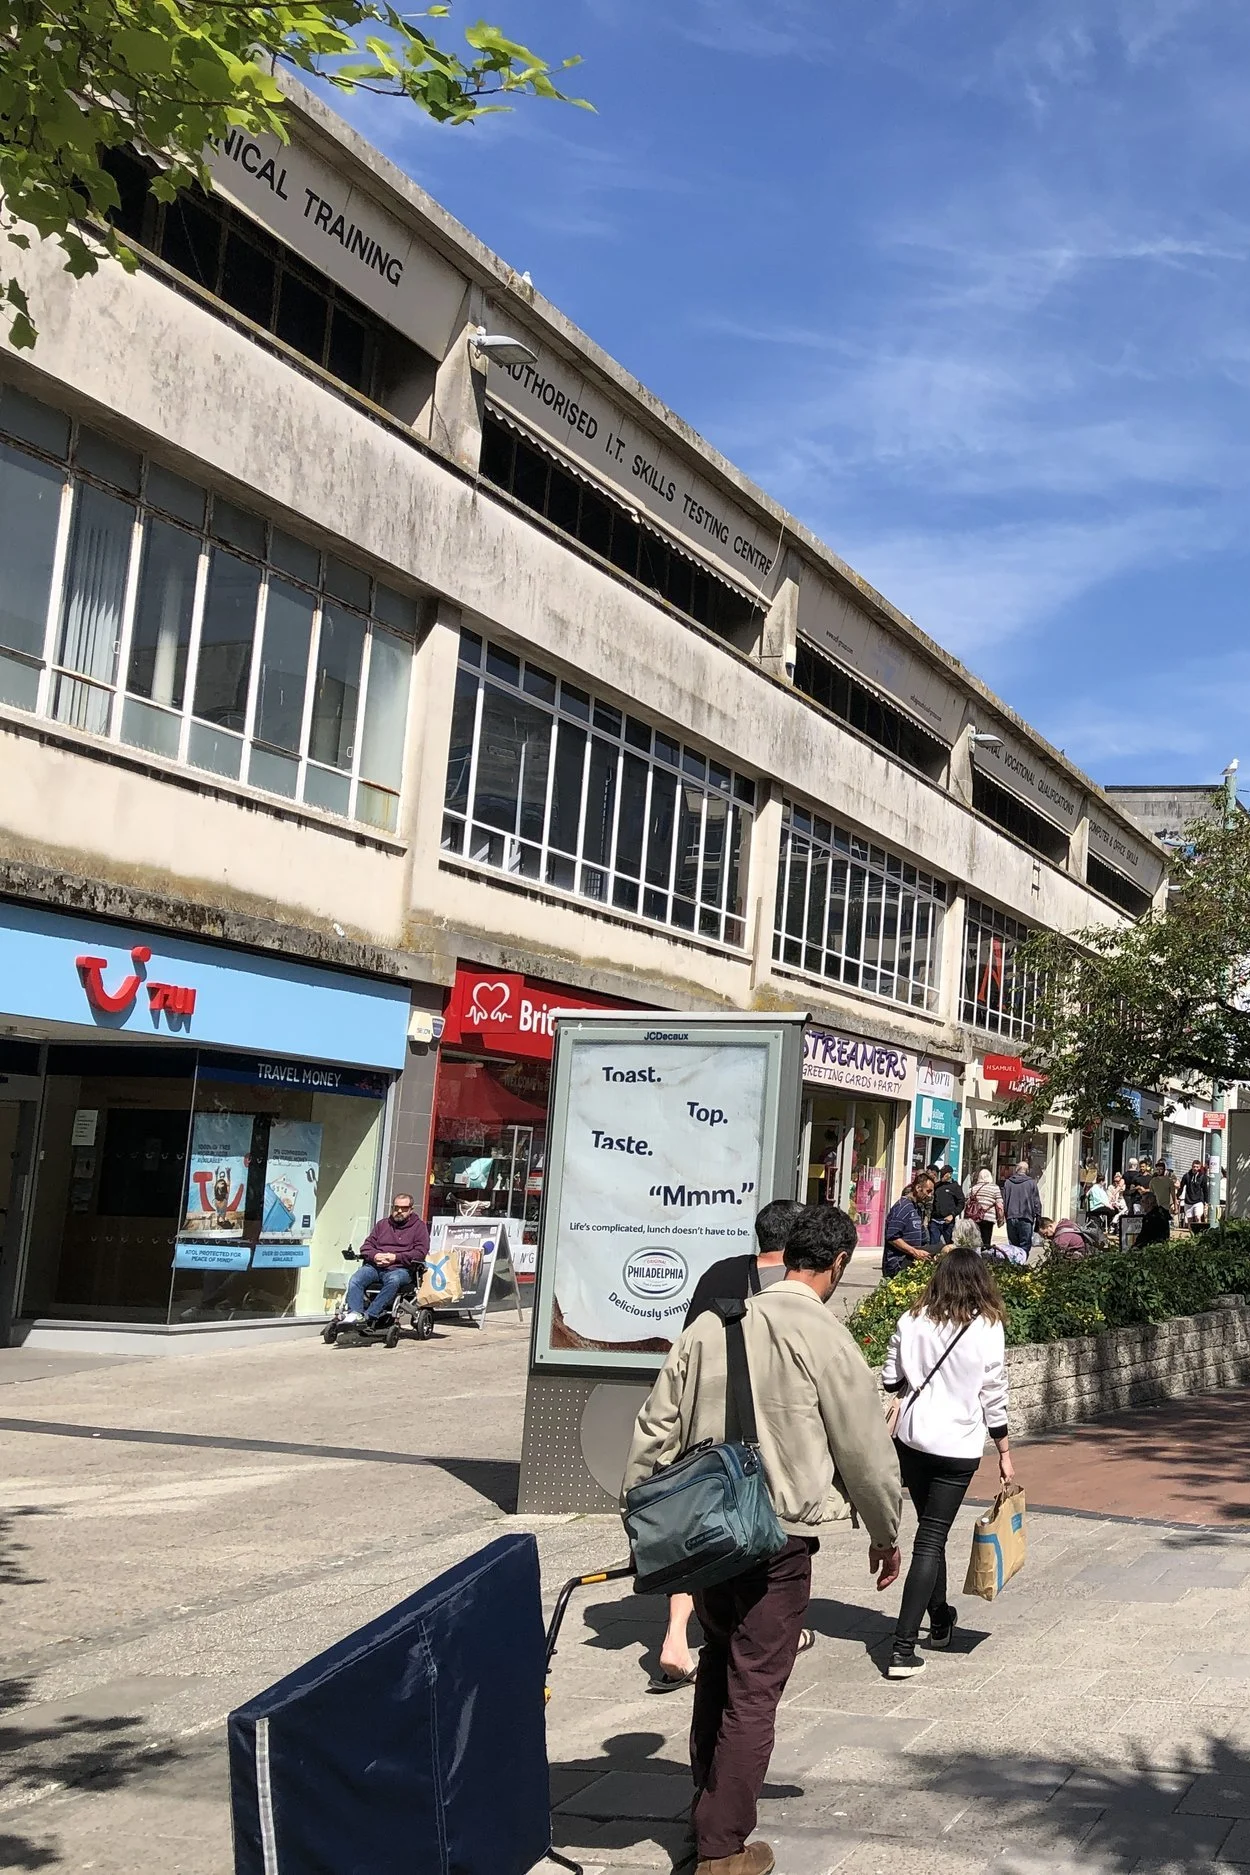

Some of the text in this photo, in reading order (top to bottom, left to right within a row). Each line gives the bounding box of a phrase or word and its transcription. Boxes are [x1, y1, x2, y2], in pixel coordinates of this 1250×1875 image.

[209, 129, 404, 287] NICAL TRAINING
[605, 432, 626, 463] I.T.
[632, 454, 676, 502] SKILLS
[682, 494, 729, 544] TESTING
[733, 536, 773, 576] CENTRE
[1004, 752, 1075, 816] VOCATIONAL QUALIFICATIONS
[1089, 819, 1111, 844] COMPUTER
[643, 1031, 689, 1041] JCDecaux
[258, 1063, 341, 1087] TRAVEL MONEY
[602, 1066, 662, 1083] Toast.
[803, 1063, 844, 1084] GREETING
[845, 1072, 872, 1089] CARDS
[877, 1079, 902, 1094] PARTY
[687, 1101, 728, 1126] Top.
[591, 1130, 653, 1156] Taste.
[649, 1182, 754, 1207] “Mmm.”
[570, 1222, 750, 1236] Life’s complicated, lunch doesn’t have to be.
[627, 1265, 684, 1280] PHILADELPHIA
[608, 1291, 661, 1321] Deliciously
